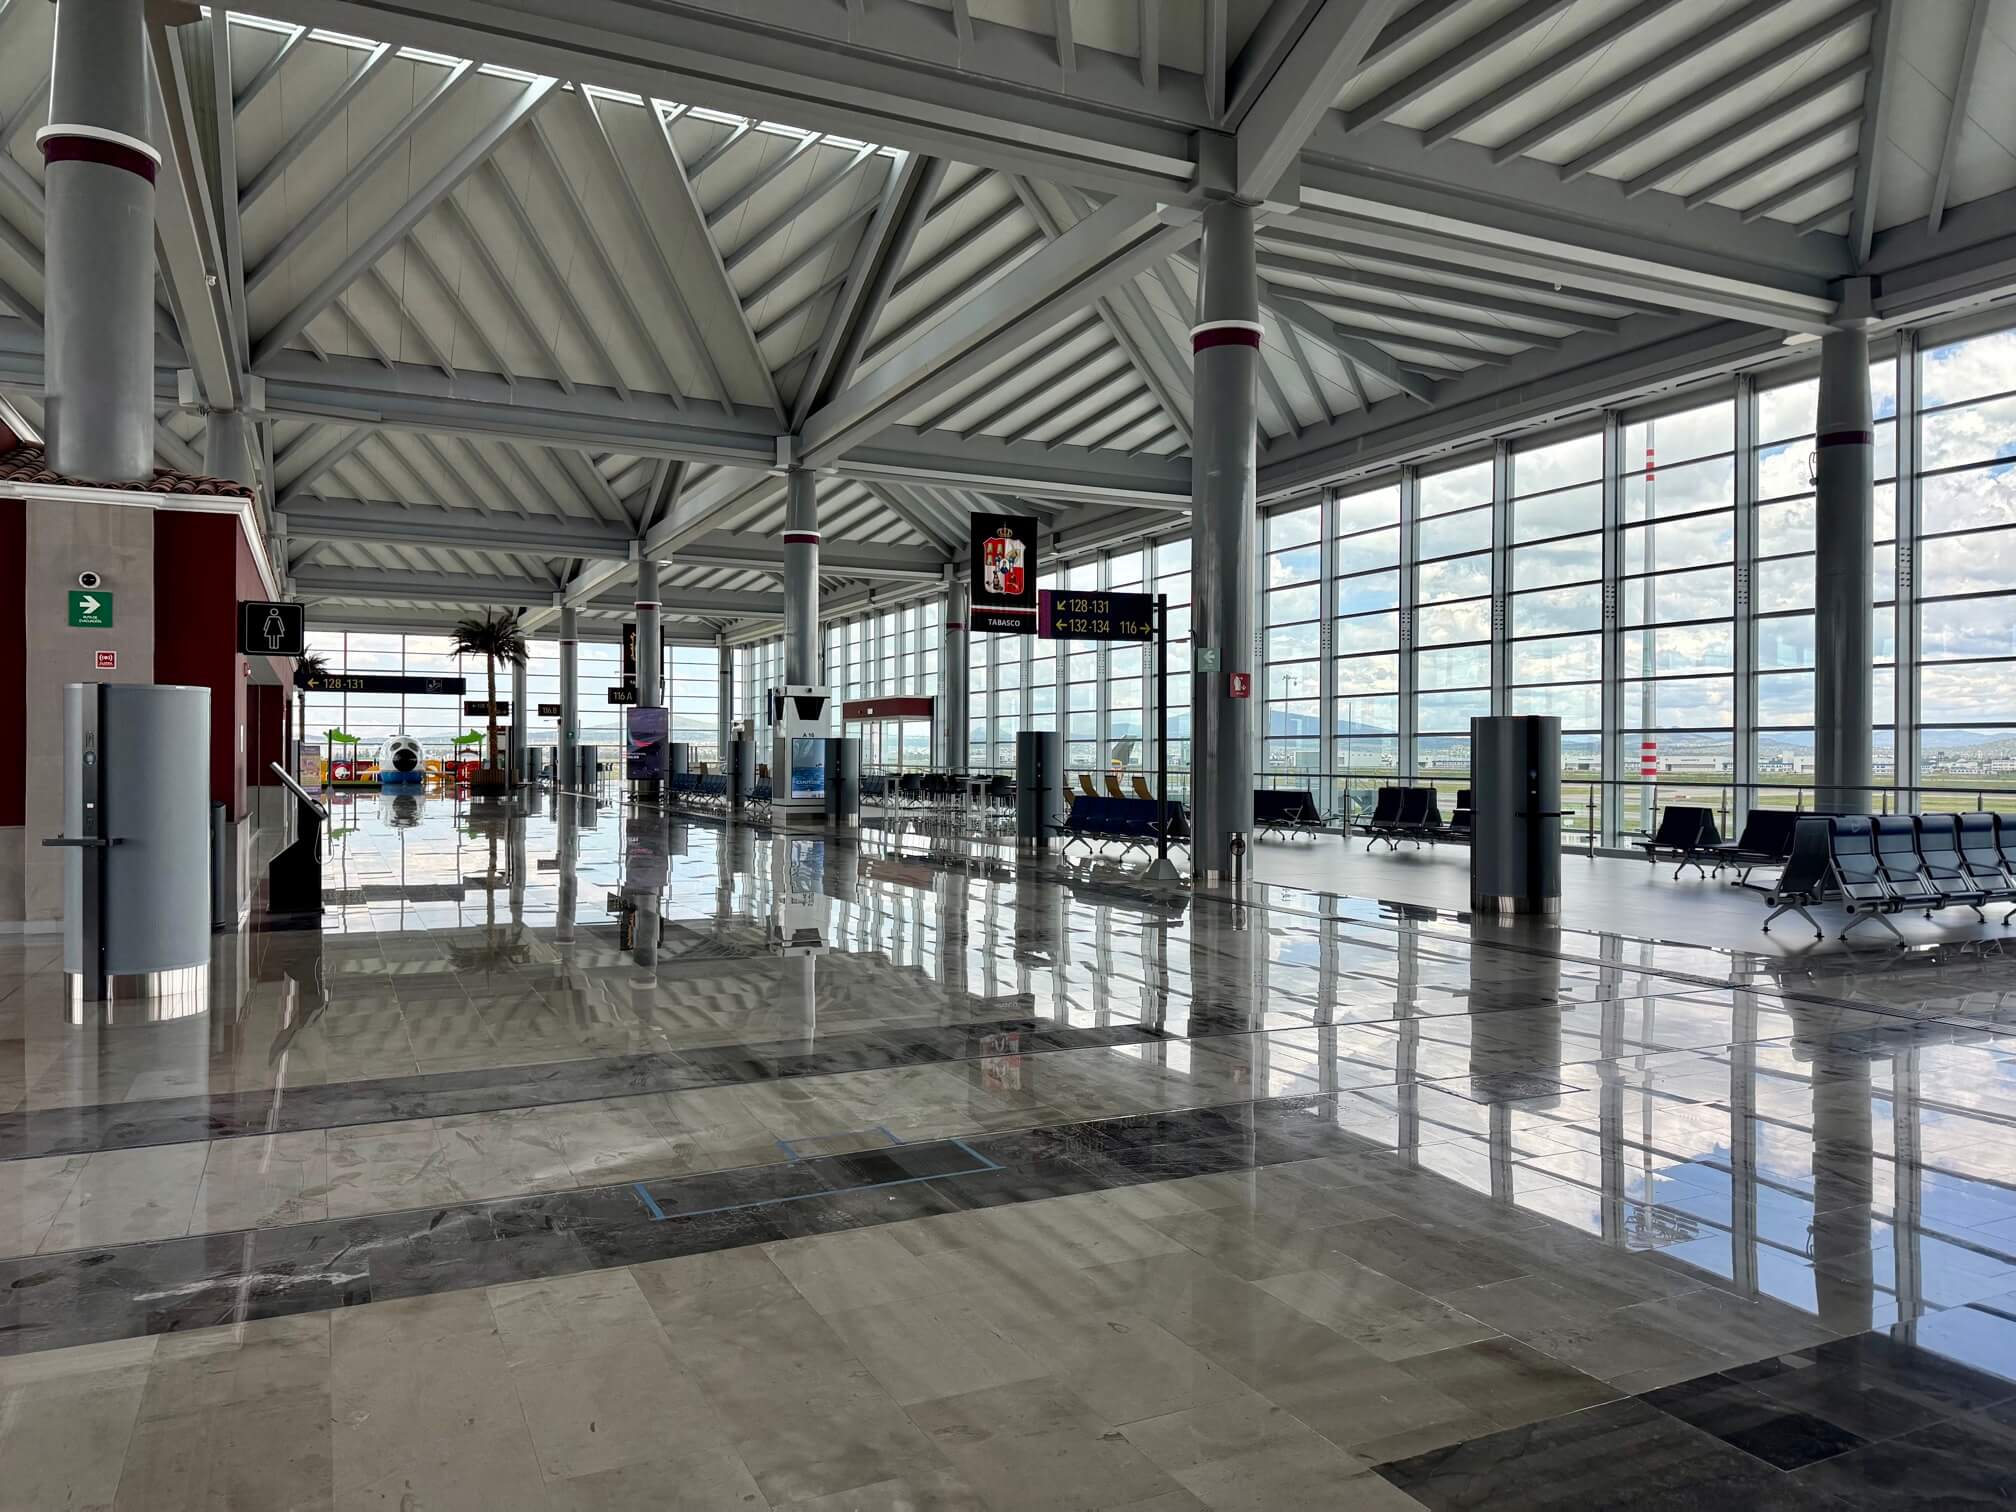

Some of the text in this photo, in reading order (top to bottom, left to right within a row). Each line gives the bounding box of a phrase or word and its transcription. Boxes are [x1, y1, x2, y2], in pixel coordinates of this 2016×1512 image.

[1068, 599, 1109, 613] 128-131
[987, 618, 1021, 627] TABASCO
[1068, 619, 1137, 634] 132-134 116
[323, 678, 364, 689] 128-131
[613, 691, 633, 701] 116 A
